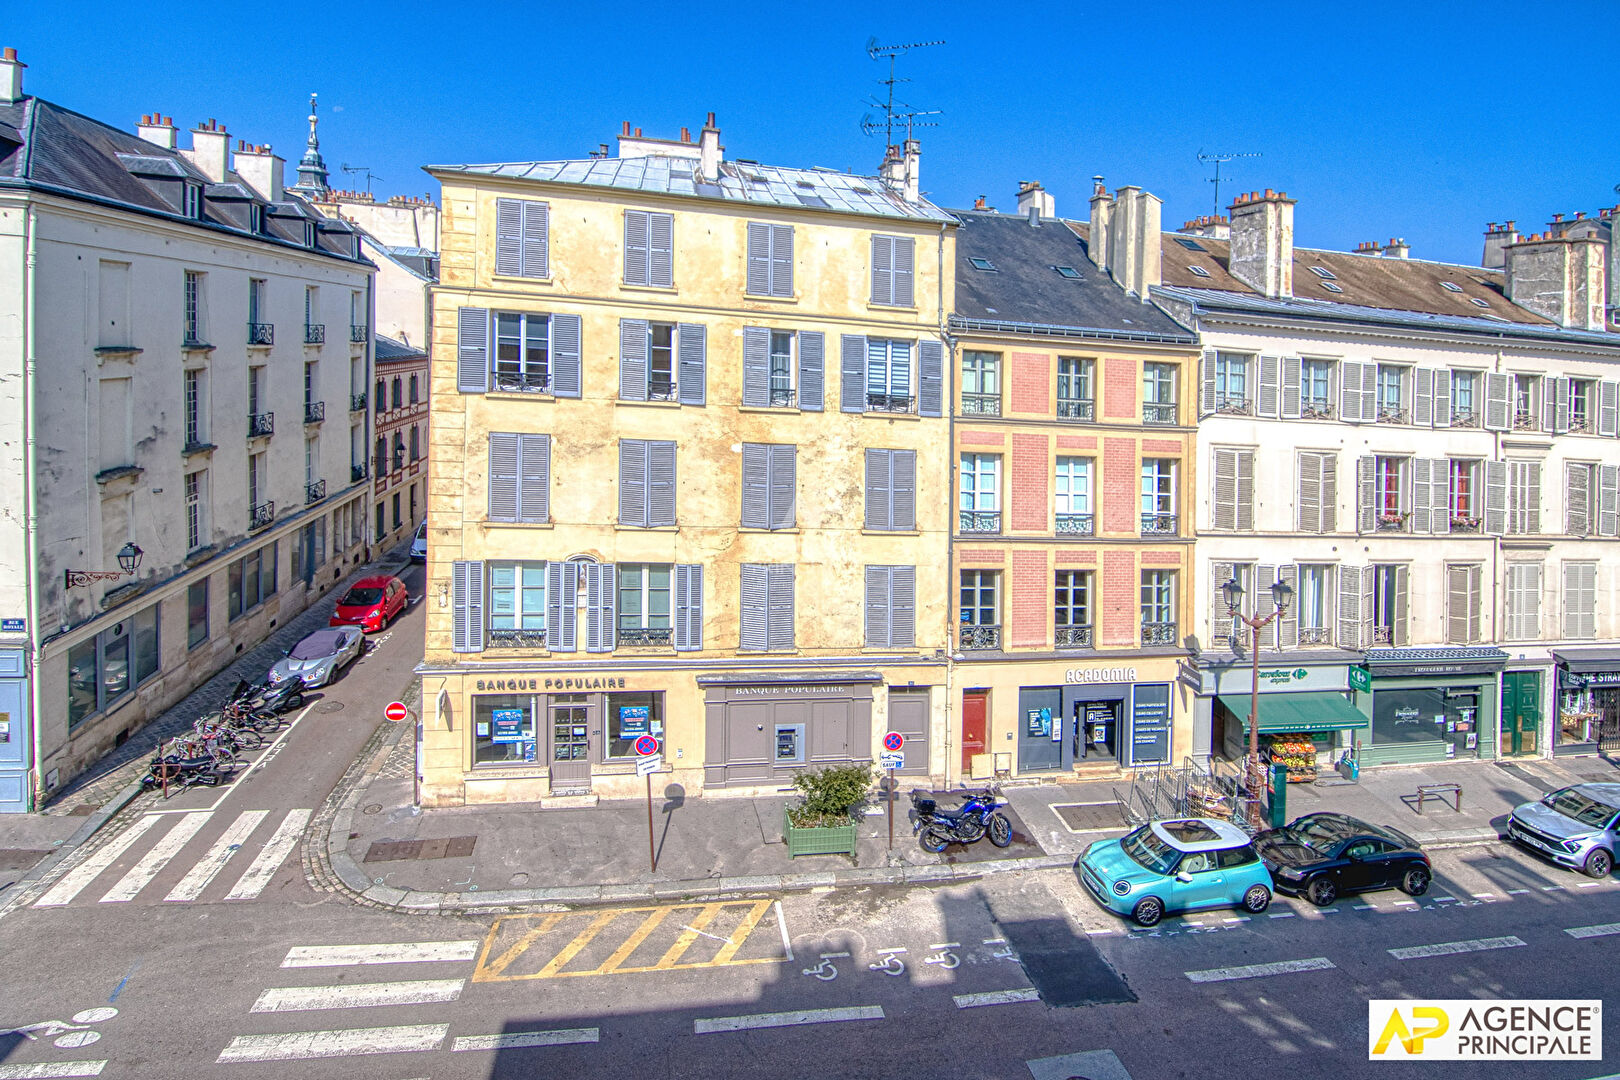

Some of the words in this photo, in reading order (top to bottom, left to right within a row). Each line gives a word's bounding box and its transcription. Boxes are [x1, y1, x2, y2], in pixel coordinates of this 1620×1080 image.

[1066, 667, 1137, 683] ACADOMIA
[476, 678, 537, 691] BANQUE
[545, 677, 626, 690] POPULAIRE
[735, 686, 780, 696] BANQUE
[784, 685, 845, 694] POPULAIRE
[1406, 899, 1497, 912] PAYANT
[1127, 925, 1236, 939] PAYANT
